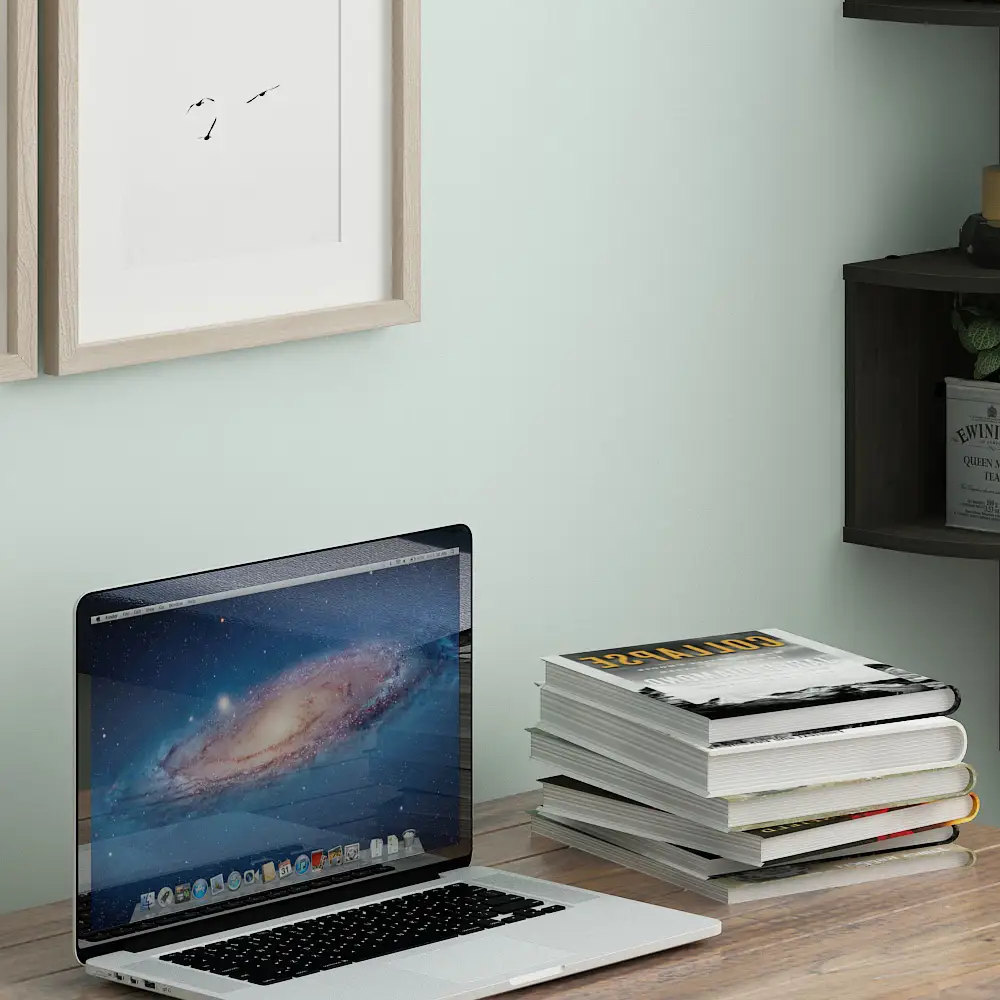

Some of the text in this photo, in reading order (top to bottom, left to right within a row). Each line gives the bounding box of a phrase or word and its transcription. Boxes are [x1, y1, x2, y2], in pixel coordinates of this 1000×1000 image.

[963, 455, 992, 468] QUEEN
[984, 471, 1000, 483] TEA
[280, 865, 290, 875] 31
